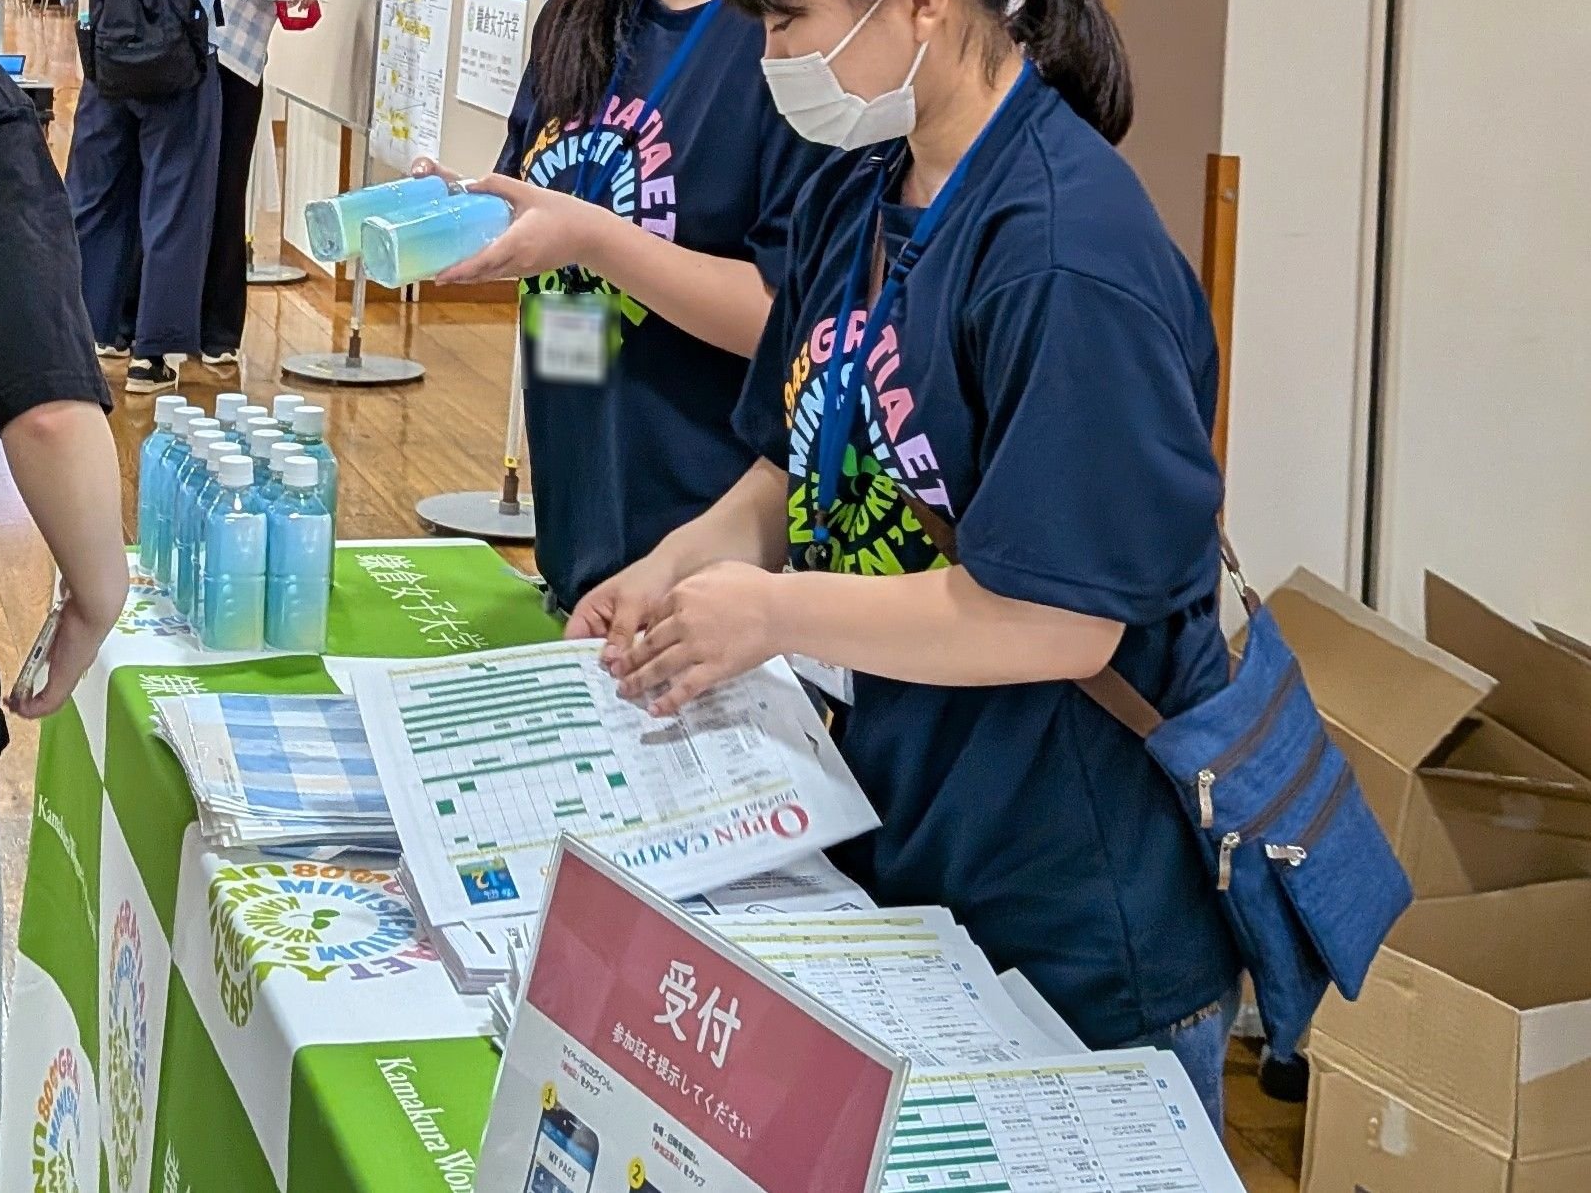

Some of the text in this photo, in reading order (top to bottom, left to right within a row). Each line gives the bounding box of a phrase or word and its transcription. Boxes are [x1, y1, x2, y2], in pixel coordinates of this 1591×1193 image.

[894, 432, 956, 519] ET
[354, 553, 489, 650] 鎌倉女子大学
[613, 833, 709, 869] CAMPU
[654, 960, 742, 1069] 受付
[375, 1056, 450, 1153] Kamakura
[611, 1021, 752, 1140] 参加証を提示してください
[558, 1156, 577, 1183] PAGE
